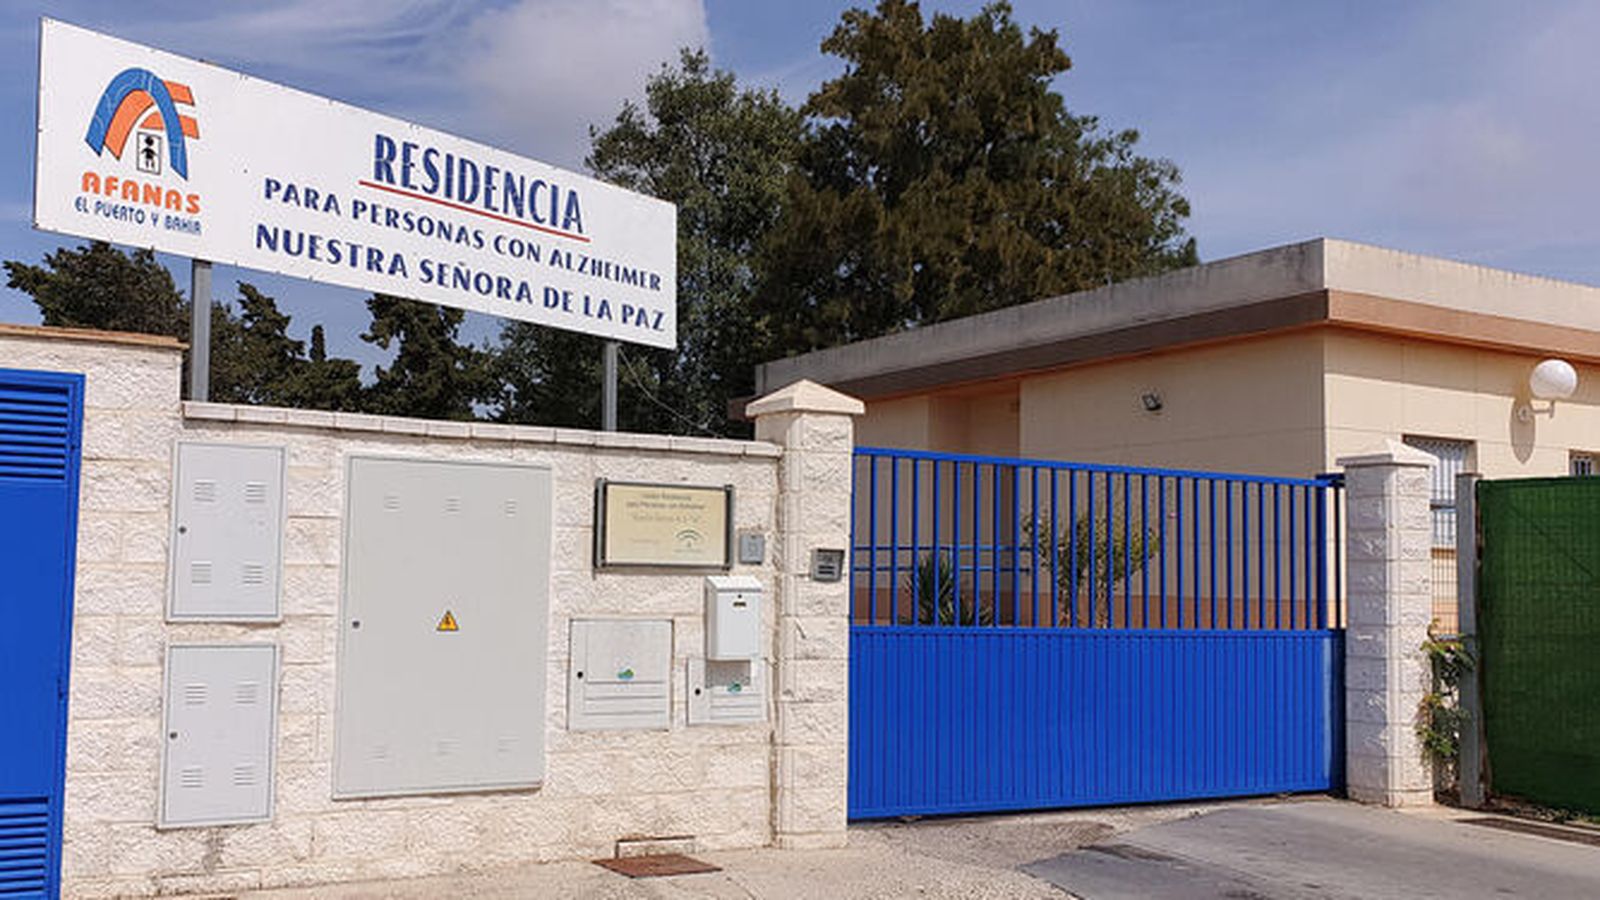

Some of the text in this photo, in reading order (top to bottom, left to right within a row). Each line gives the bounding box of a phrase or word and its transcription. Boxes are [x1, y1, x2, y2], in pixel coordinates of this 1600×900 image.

[75, 196, 89, 213] EL
[95, 201, 145, 224] PUERTO
[151, 213, 159, 227] Y
[82, 172, 200, 214] AFANAS
[374, 134, 583, 234] RESIDENCIA
[256, 224, 665, 332] NUESTRA SEÑORA DE LA PAZ
[264, 178, 661, 291] PARA PERSONAS CON ALZHEIMER
